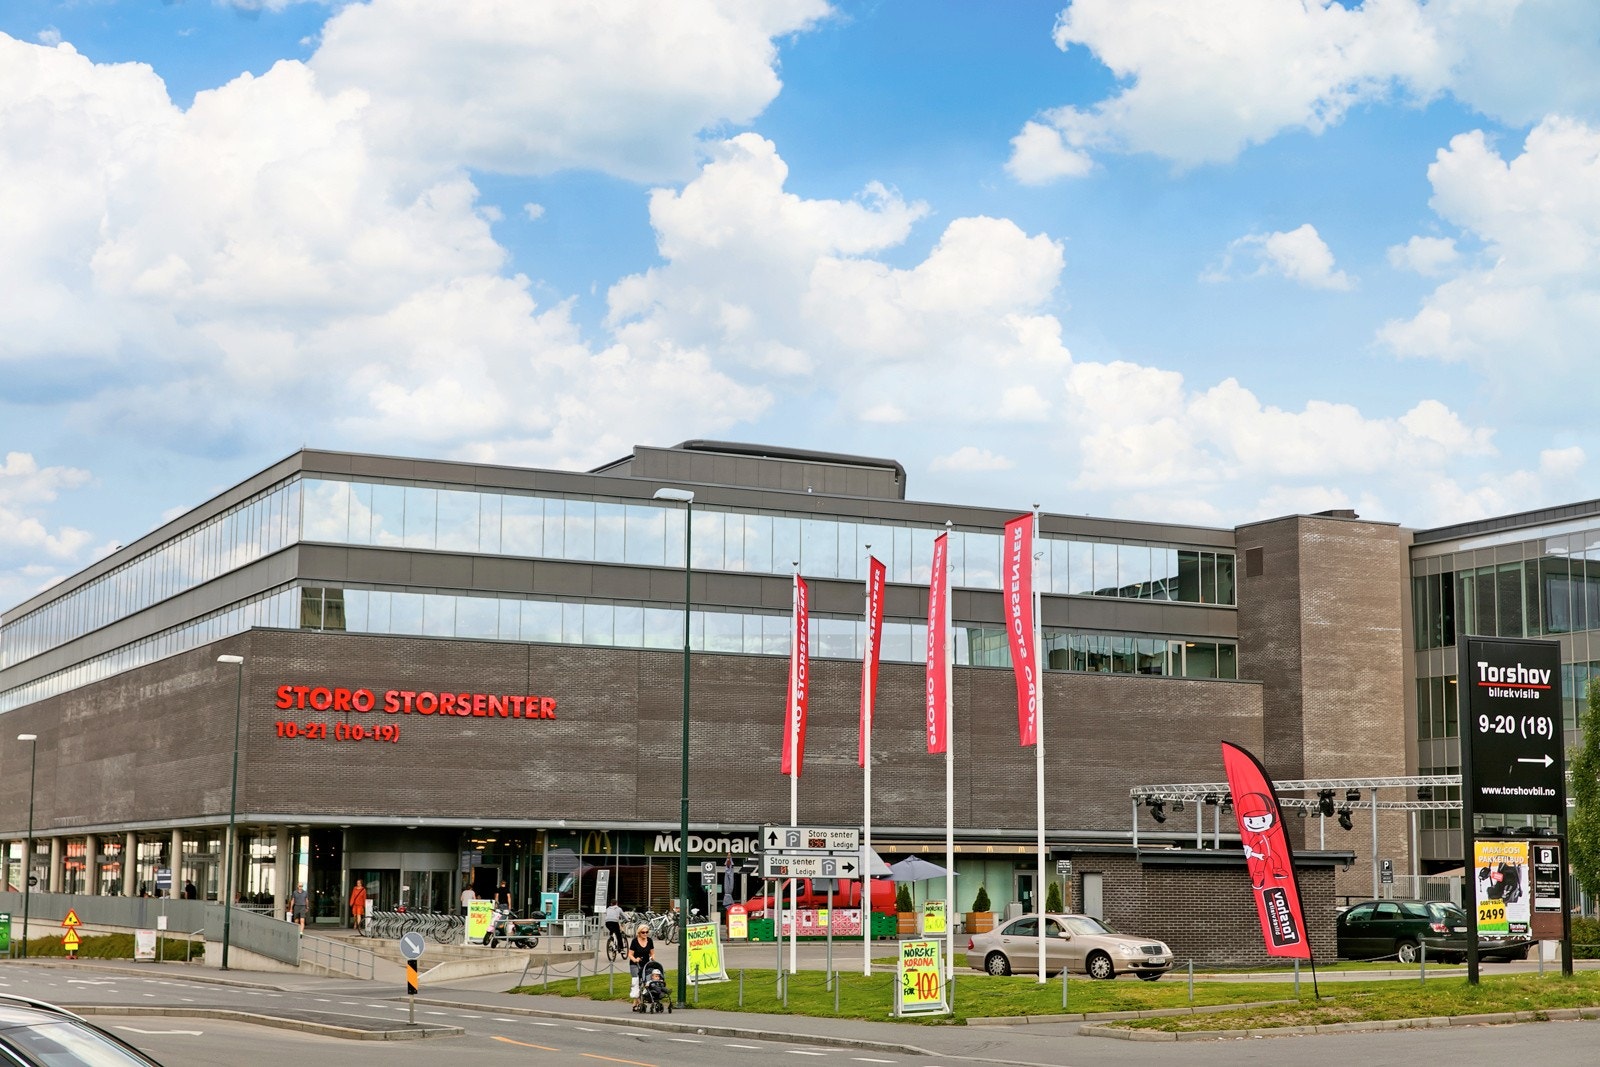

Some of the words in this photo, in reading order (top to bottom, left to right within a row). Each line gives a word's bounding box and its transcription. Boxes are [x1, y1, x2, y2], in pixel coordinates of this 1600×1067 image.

[1477, 661, 1551, 685] Torshov
[1488, 687, 1540, 699] bilrekvisita
[276, 685, 375, 713] STORO
[383, 690, 557, 719] STORSENTER
[276, 721, 327, 739] 10-21
[334, 721, 400, 743] (10-19)
[1479, 714, 1516, 734] 9-20
[1520, 715, 1554, 740] (18)
[1481, 786, 1556, 796] www.torshovbil.no
[809, 830, 827, 838] Storo
[833, 841, 853, 849] Ledige
[770, 857, 789, 865] Storo
[795, 868, 817, 876] Ledige
[1479, 908, 1505, 921] 2499
[903, 947, 936, 958] NORSKE
[903, 958, 934, 967] KORONA
